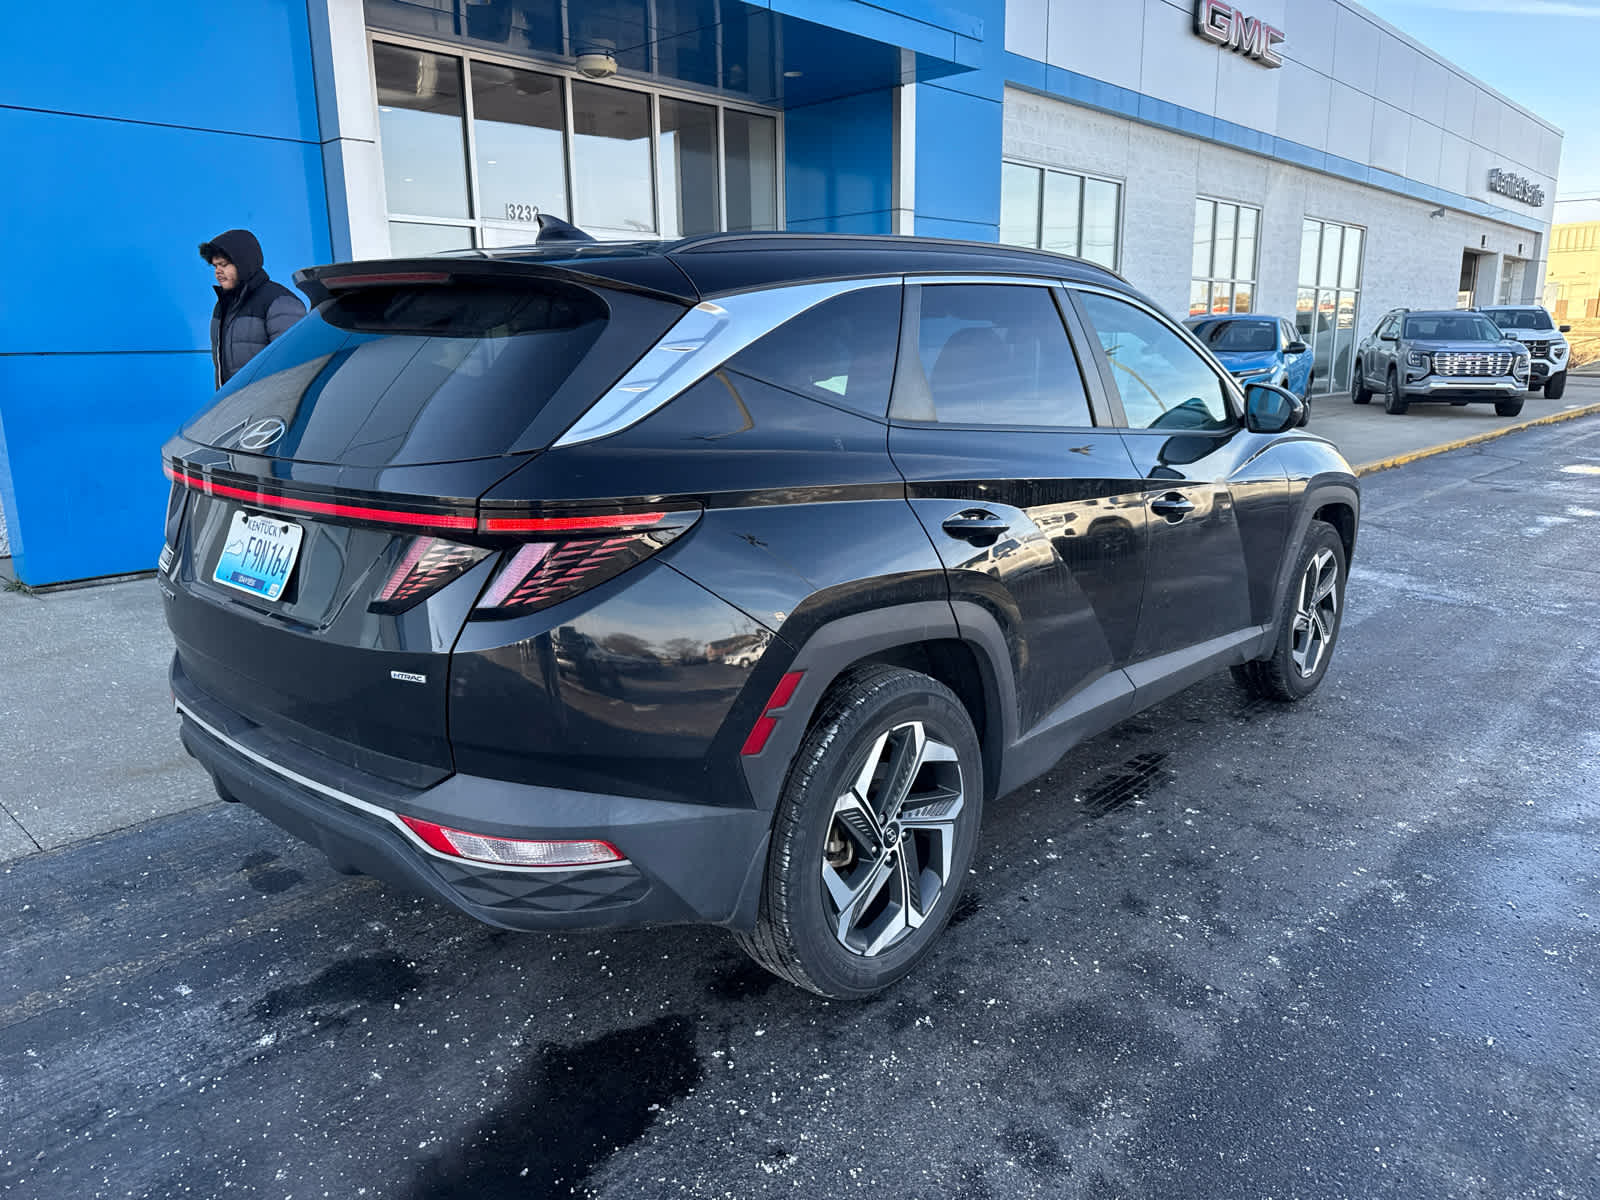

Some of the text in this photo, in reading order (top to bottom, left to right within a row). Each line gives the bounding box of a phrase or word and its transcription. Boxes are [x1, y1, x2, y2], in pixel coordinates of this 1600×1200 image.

[1201, 0, 1285, 67] GMC
[241, 536, 294, 580] F9N164
[392, 671, 425, 682] HTRAC
